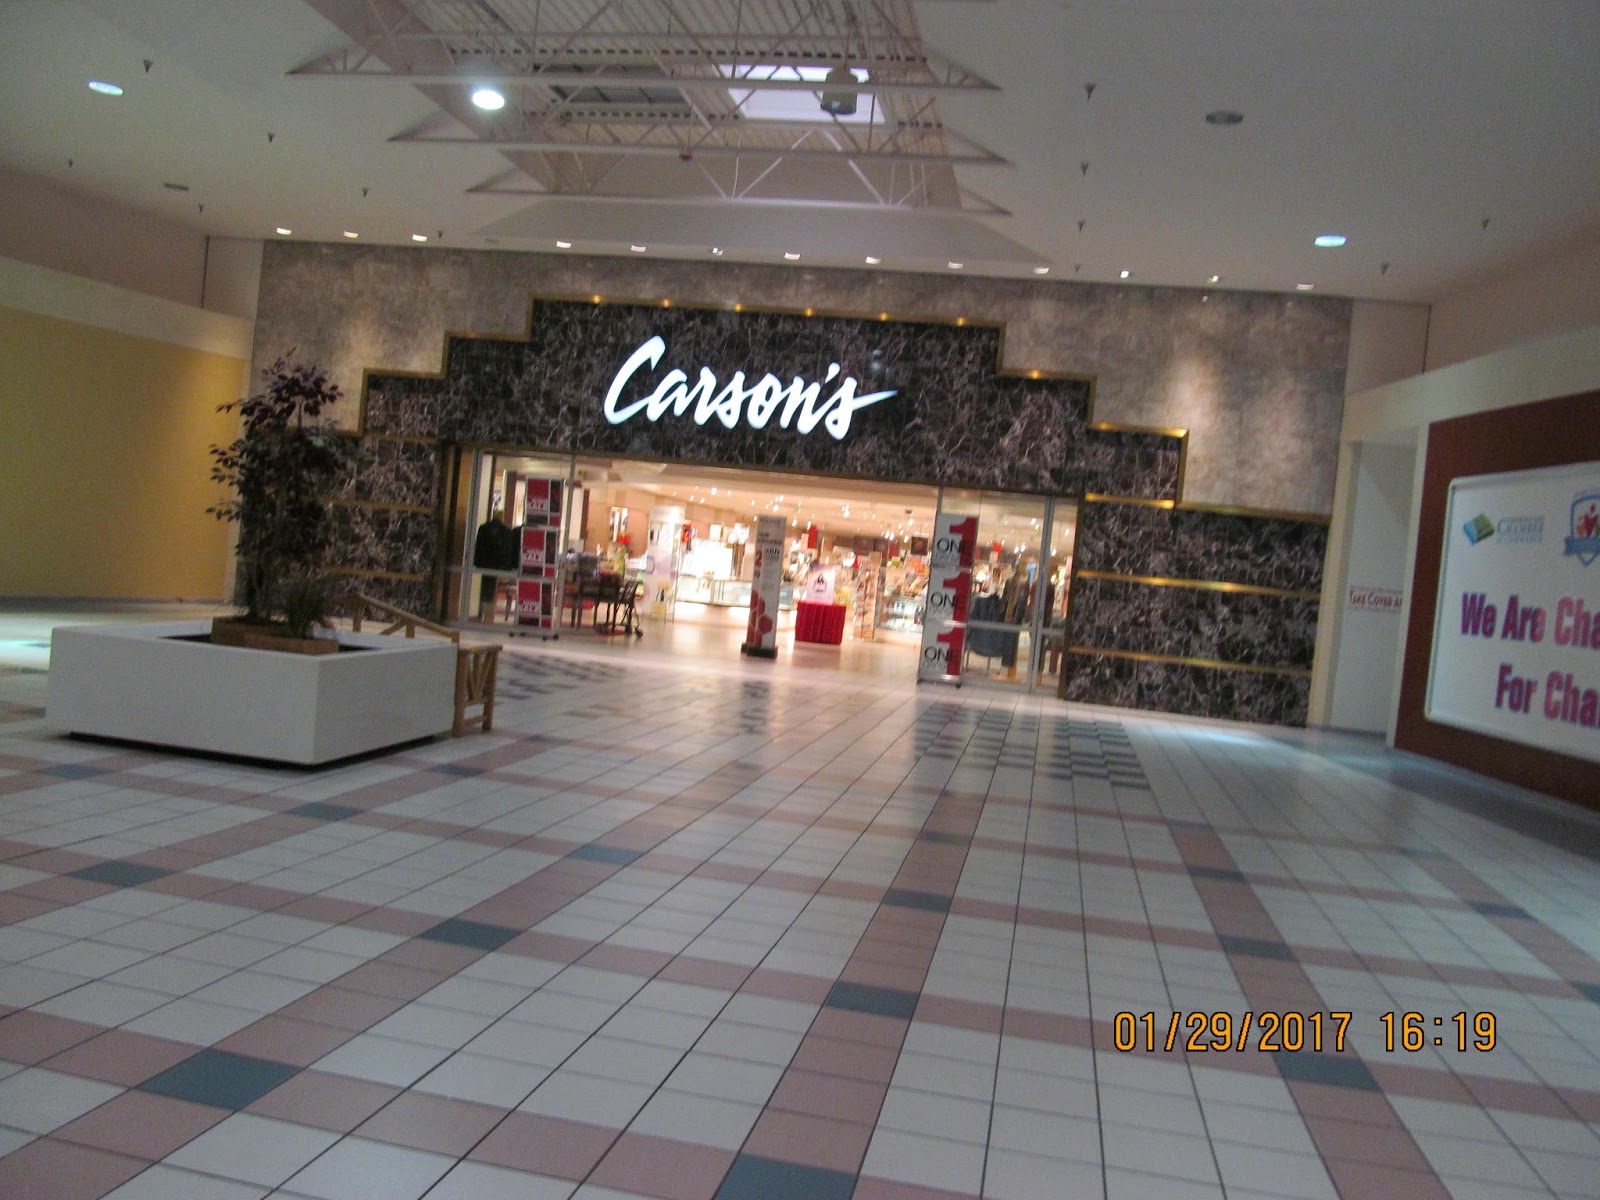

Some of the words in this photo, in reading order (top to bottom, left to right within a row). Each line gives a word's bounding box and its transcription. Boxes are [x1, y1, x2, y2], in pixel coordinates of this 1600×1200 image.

[603, 335, 898, 440] Carson's
[1460, 592, 1496, 639] We
[1501, 593, 1547, 643] Are
[1495, 662, 1538, 714] For
